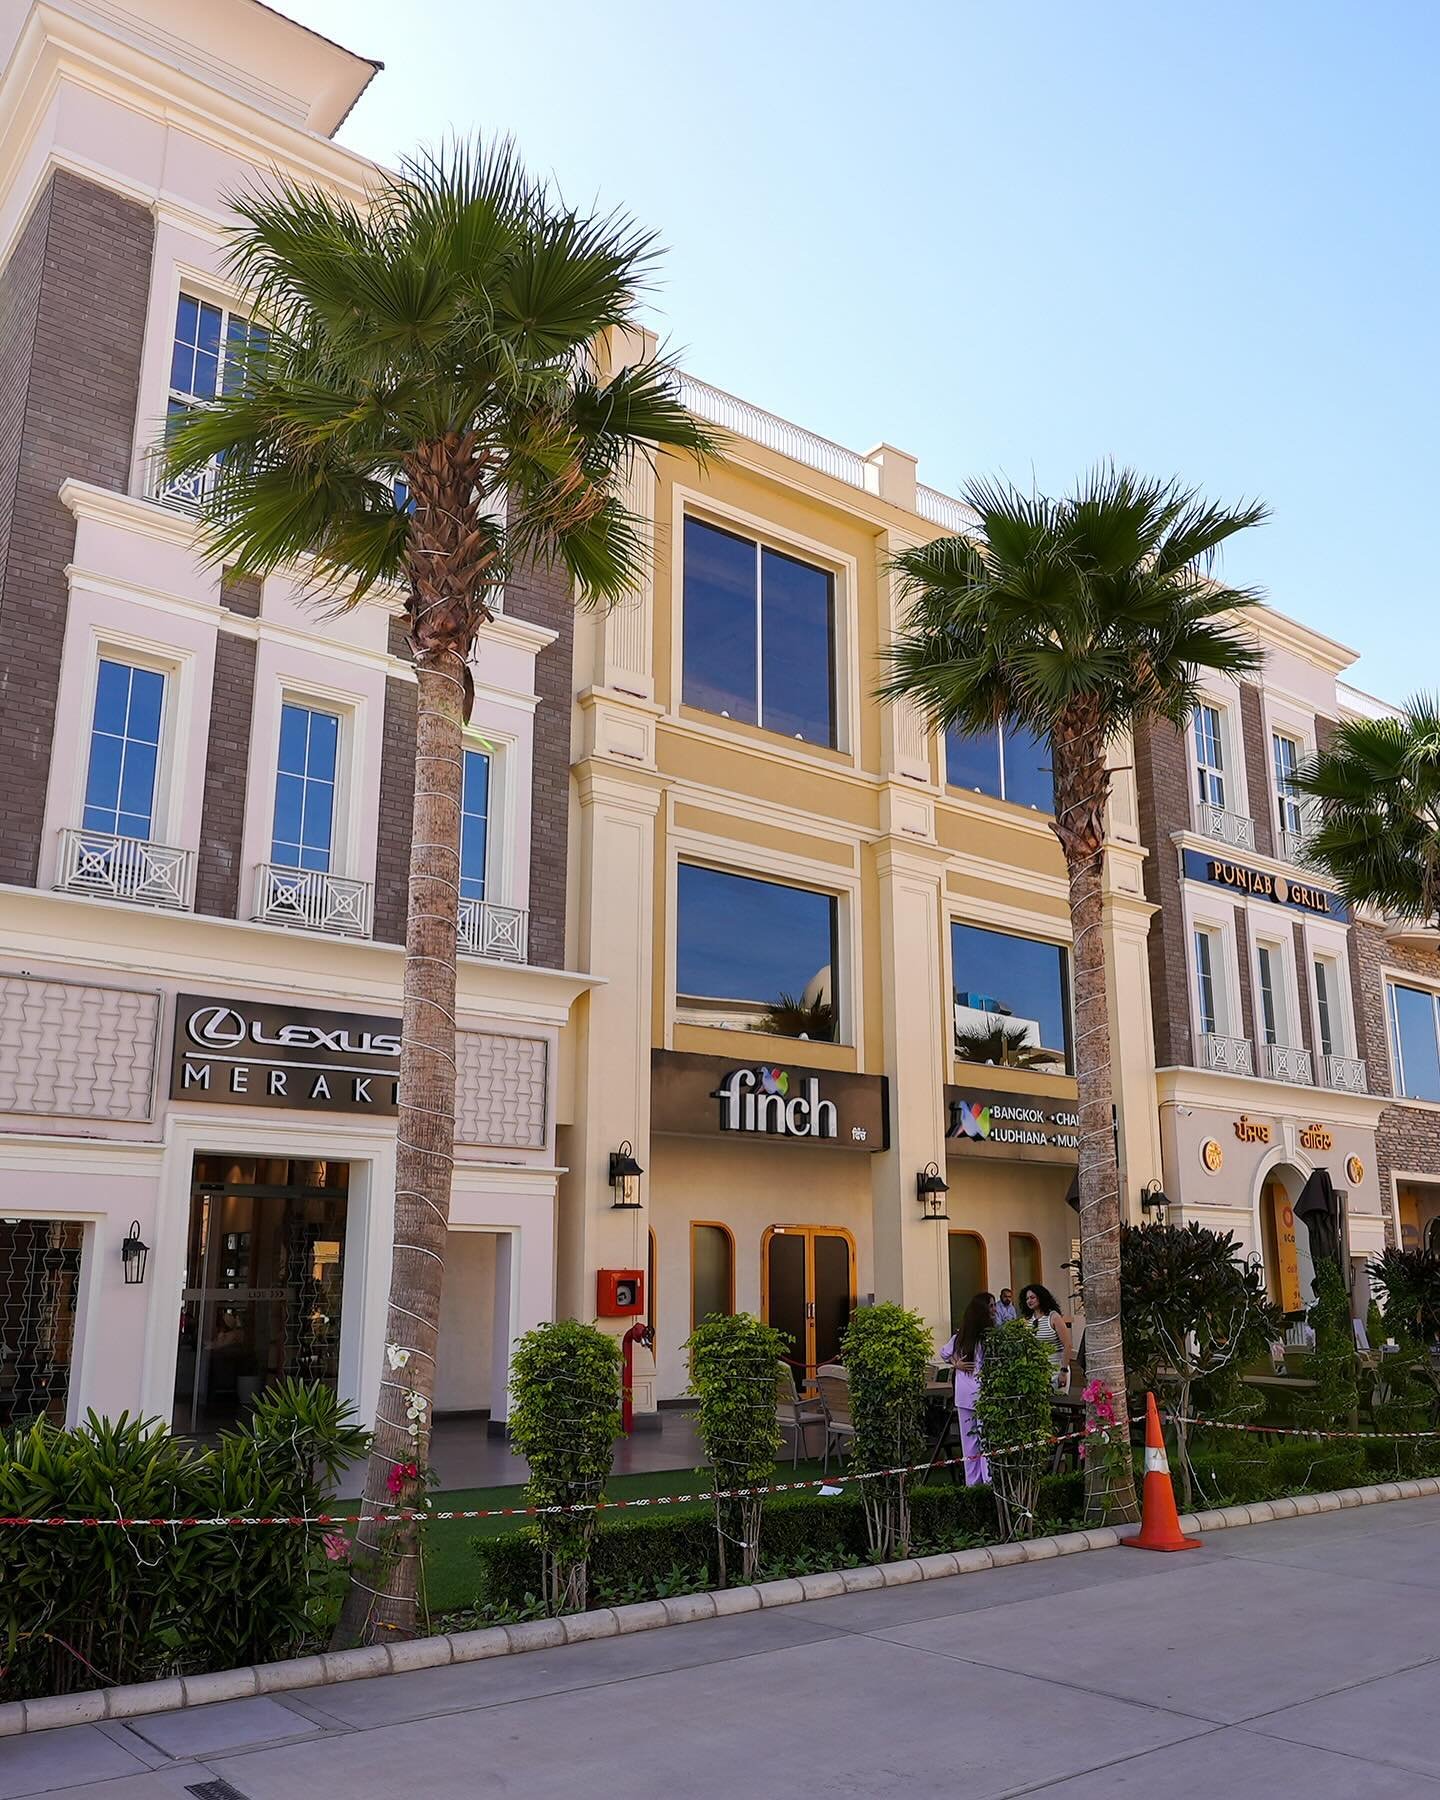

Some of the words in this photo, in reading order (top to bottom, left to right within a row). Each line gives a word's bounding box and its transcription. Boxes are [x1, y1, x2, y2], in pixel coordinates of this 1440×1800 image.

[1213, 861, 1273, 895] PUNJAB
[1291, 885, 1331, 912] GRILL
[250, 1021, 401, 1056] LEXUS
[716, 1069, 838, 1138] finch
[994, 1105, 1044, 1123] BANGKOK
[1056, 1112, 1079, 1126] CHA
[994, 1128, 1047, 1145] LUDHIANA
